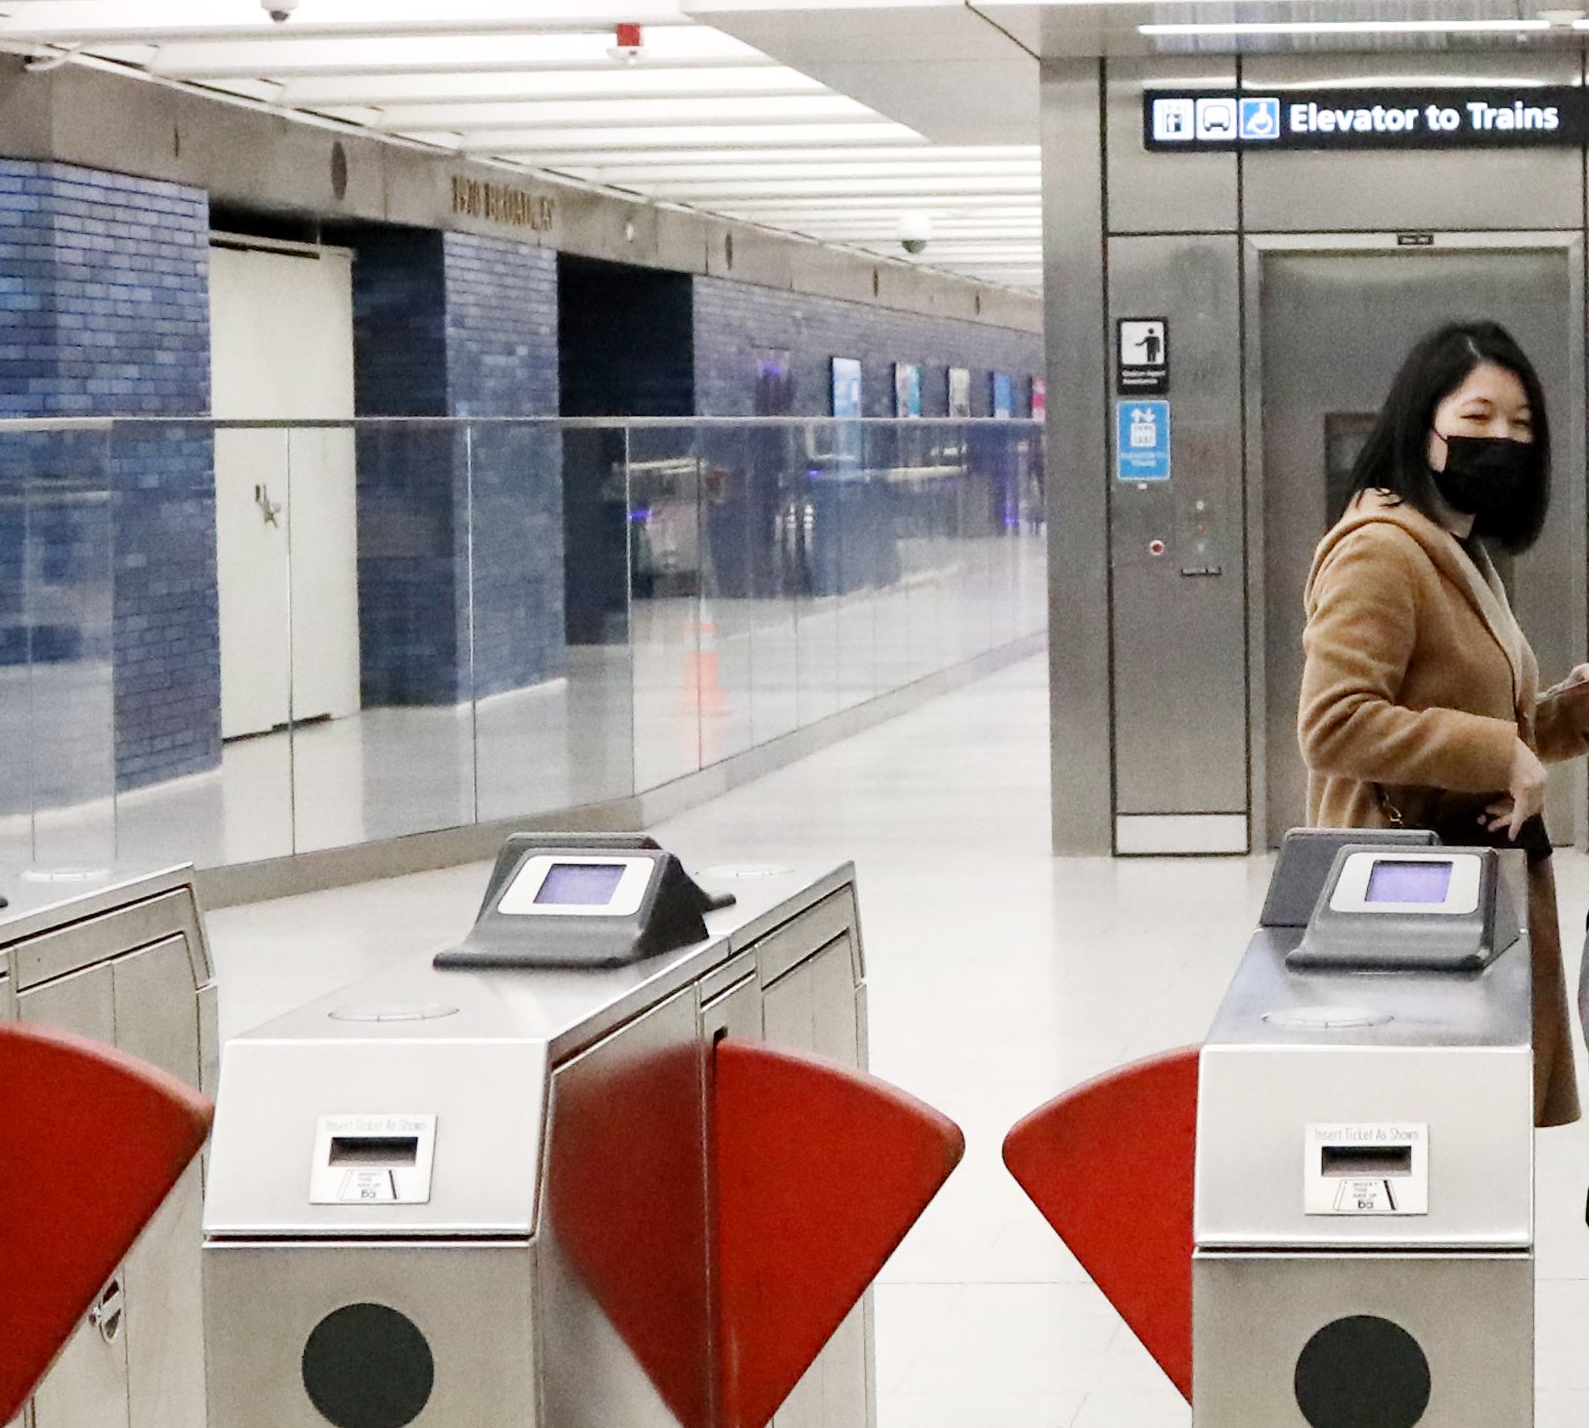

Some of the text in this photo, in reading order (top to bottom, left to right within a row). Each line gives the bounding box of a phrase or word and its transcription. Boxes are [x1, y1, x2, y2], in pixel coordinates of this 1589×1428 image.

[1289, 100, 1560, 132] Elevator to Trains
[1314, 1127, 1419, 1141] Insert Ticket As Shown
